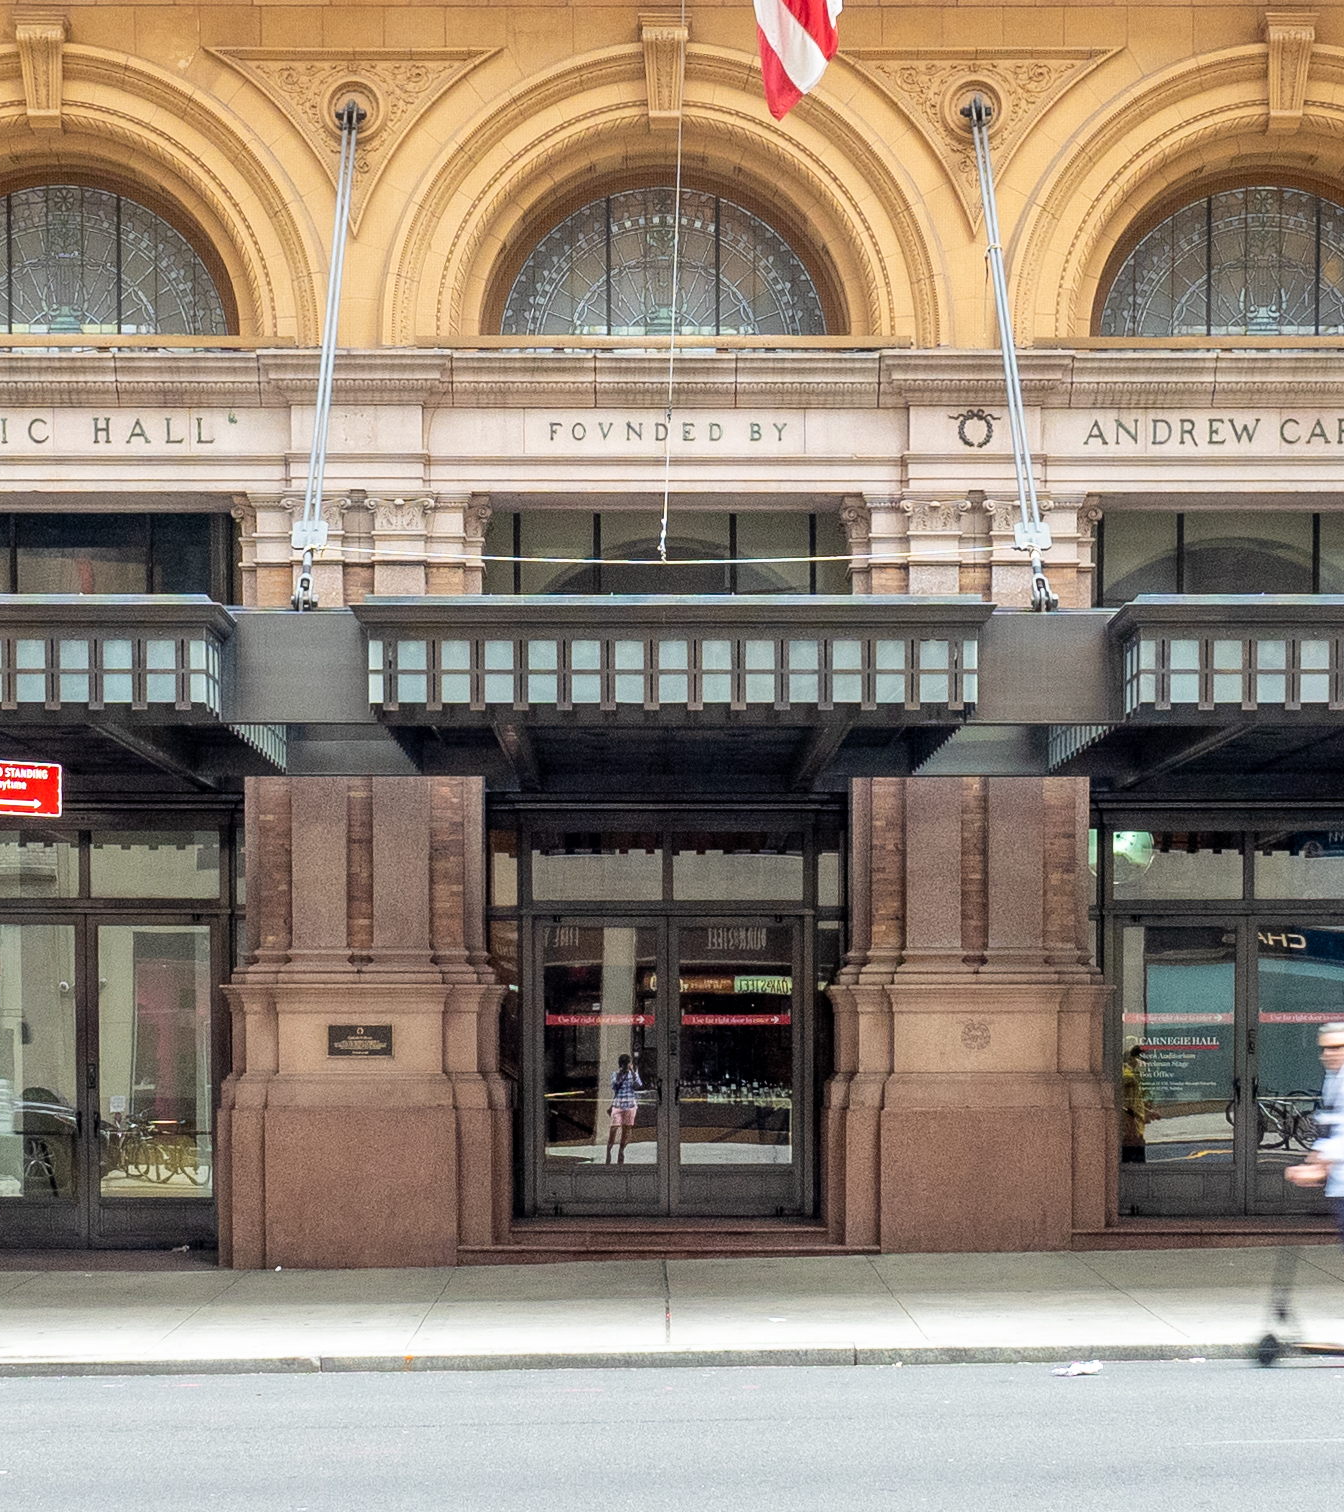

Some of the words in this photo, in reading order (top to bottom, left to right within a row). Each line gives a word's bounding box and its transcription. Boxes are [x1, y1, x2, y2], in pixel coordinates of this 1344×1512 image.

[749, 420, 790, 443] BY
[1083, 417, 1261, 446] ANDREW
[4, 767, 49, 780] STANDING
[1139, 1036, 1191, 1046] CARNEGIE
[1192, 1036, 1219, 1046] HALL
[1153, 1070, 1175, 1078] Office
